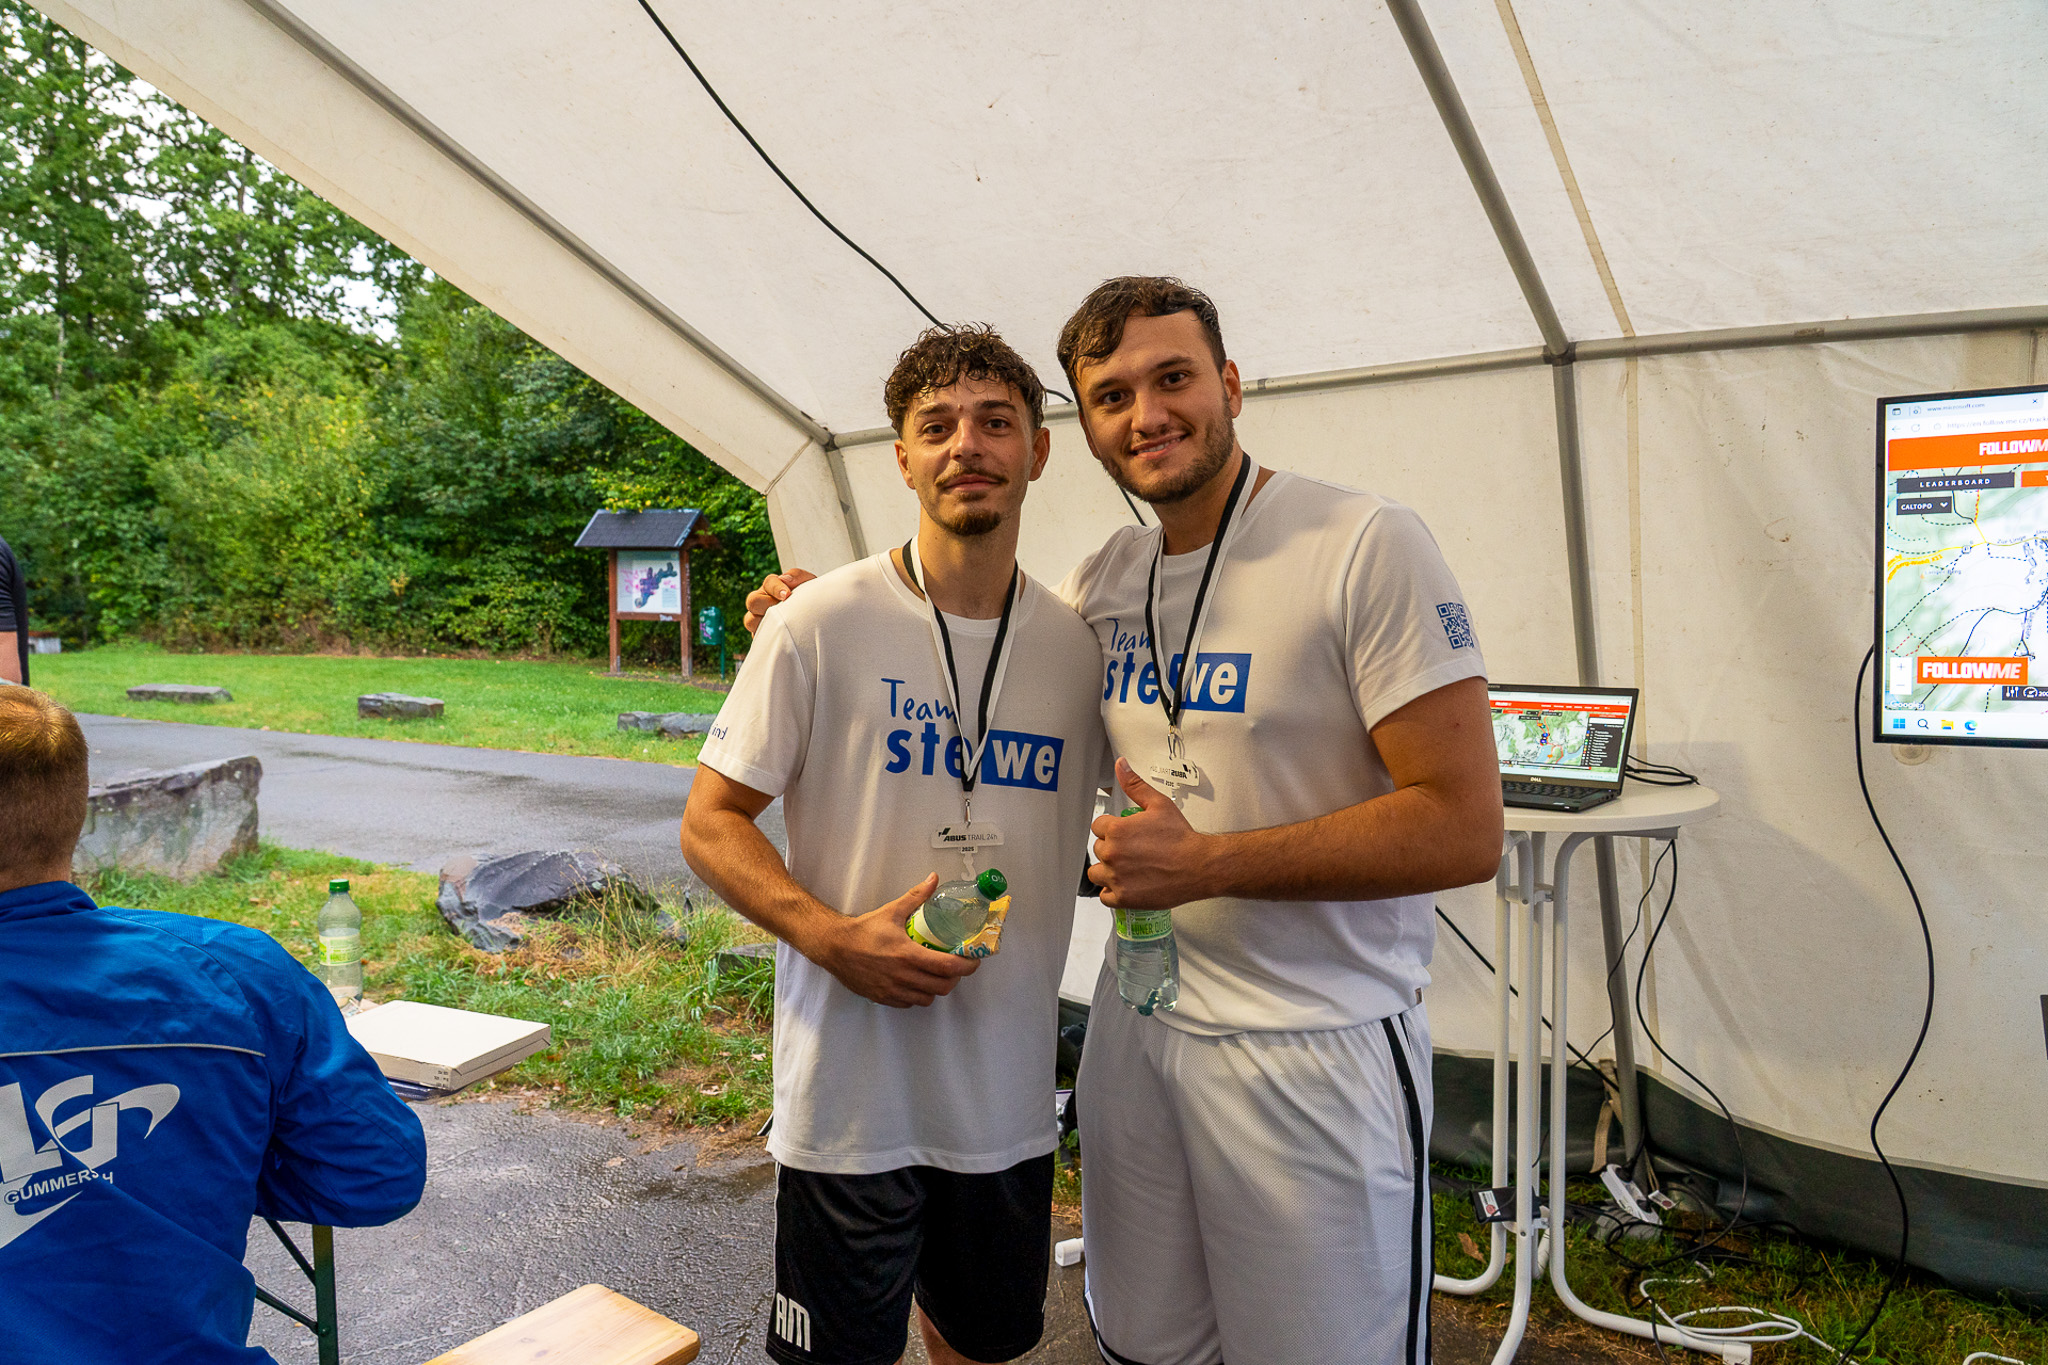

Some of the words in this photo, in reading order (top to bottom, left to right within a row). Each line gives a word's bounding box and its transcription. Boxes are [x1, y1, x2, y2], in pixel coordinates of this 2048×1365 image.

[1919, 478, 1991, 488] LEADERBOARD
[1900, 502, 1933, 511] CALTOPO
[1922, 662, 2022, 679] FOLLOWME
[881, 678, 958, 725] Team
[943, 834, 967, 842] ABUS
